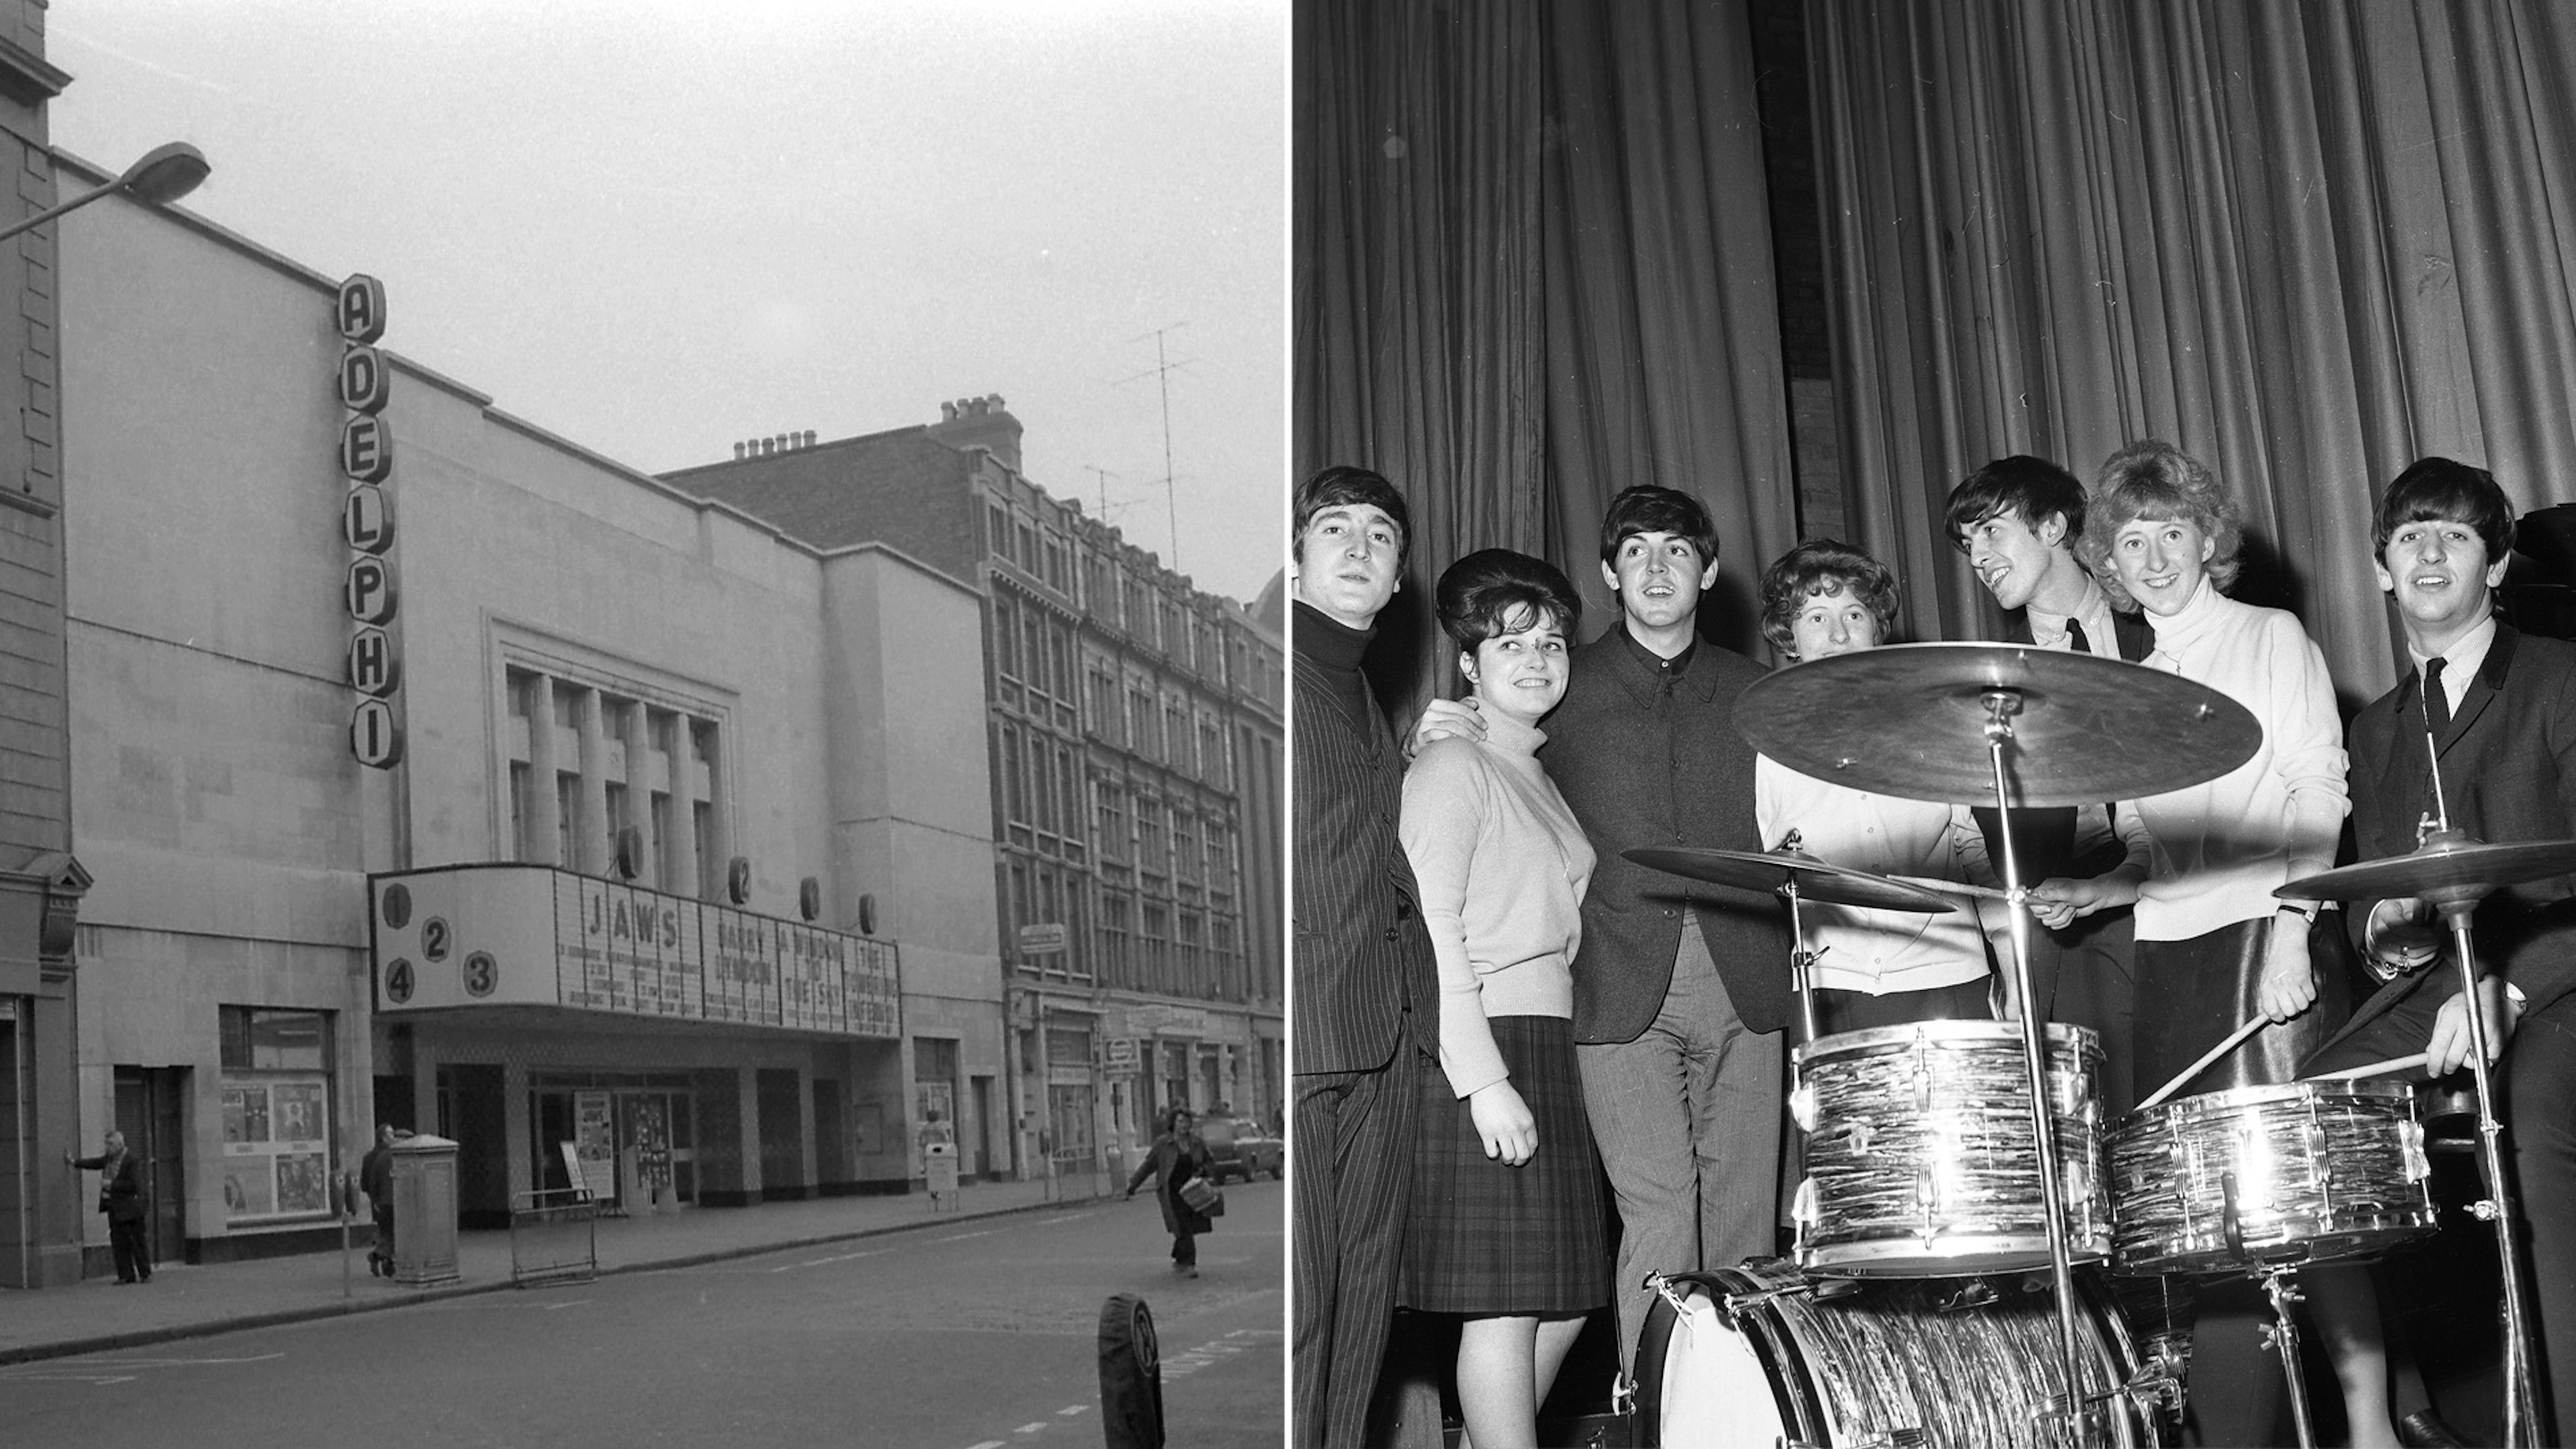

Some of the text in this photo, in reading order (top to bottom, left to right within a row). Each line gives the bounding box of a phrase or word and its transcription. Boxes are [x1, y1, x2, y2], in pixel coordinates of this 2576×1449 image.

[344, 283, 384, 758] ADELPHI
[590, 894, 677, 949] JAWS
[427, 922, 444, 957] 2
[390, 963, 410, 998] 4
[470, 957, 490, 991] 3
[785, 976, 809, 1004] THE
